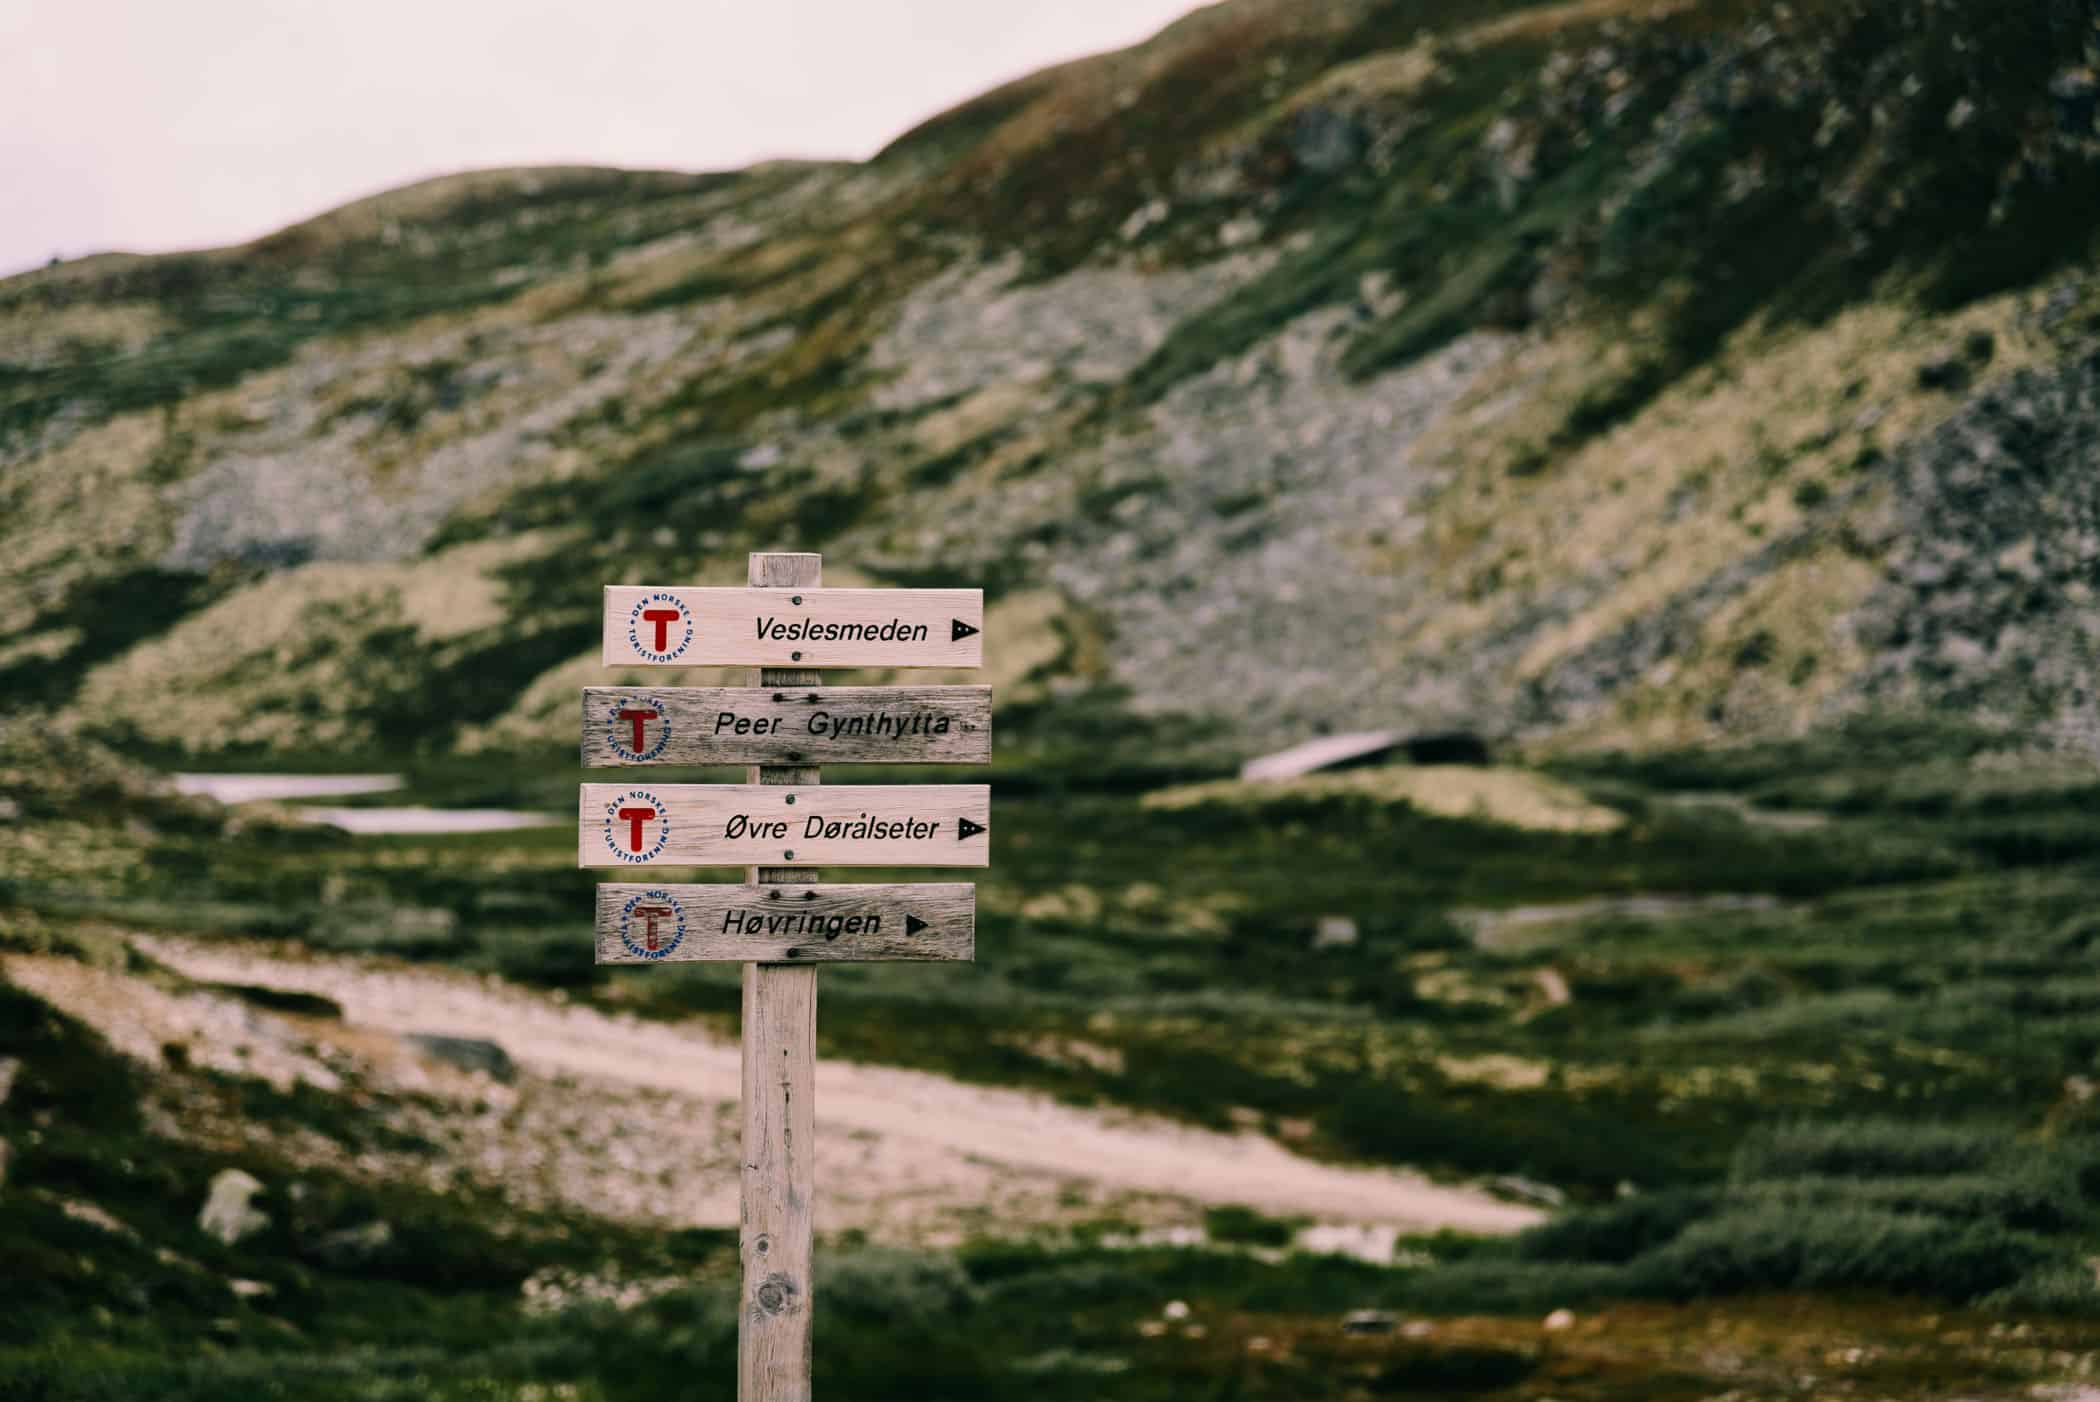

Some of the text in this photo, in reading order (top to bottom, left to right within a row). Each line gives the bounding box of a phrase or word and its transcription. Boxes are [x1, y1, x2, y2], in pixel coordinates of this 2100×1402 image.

[632, 593, 690, 617] DEN NORSKE
[643, 609, 680, 652] T
[756, 616, 928, 642] Veslesmeden
[628, 629, 693, 663] TURISTFORENING
[618, 709, 658, 754] T
[714, 711, 951, 740] Peer Gynthytta
[608, 791, 666, 816] DEN NORSKE
[618, 808, 656, 852] T
[724, 813, 940, 840] Øvre Dørålseter
[604, 827, 670, 863] TURISTFORENING
[634, 907, 672, 951] T
[722, 909, 881, 938] Høvringen
